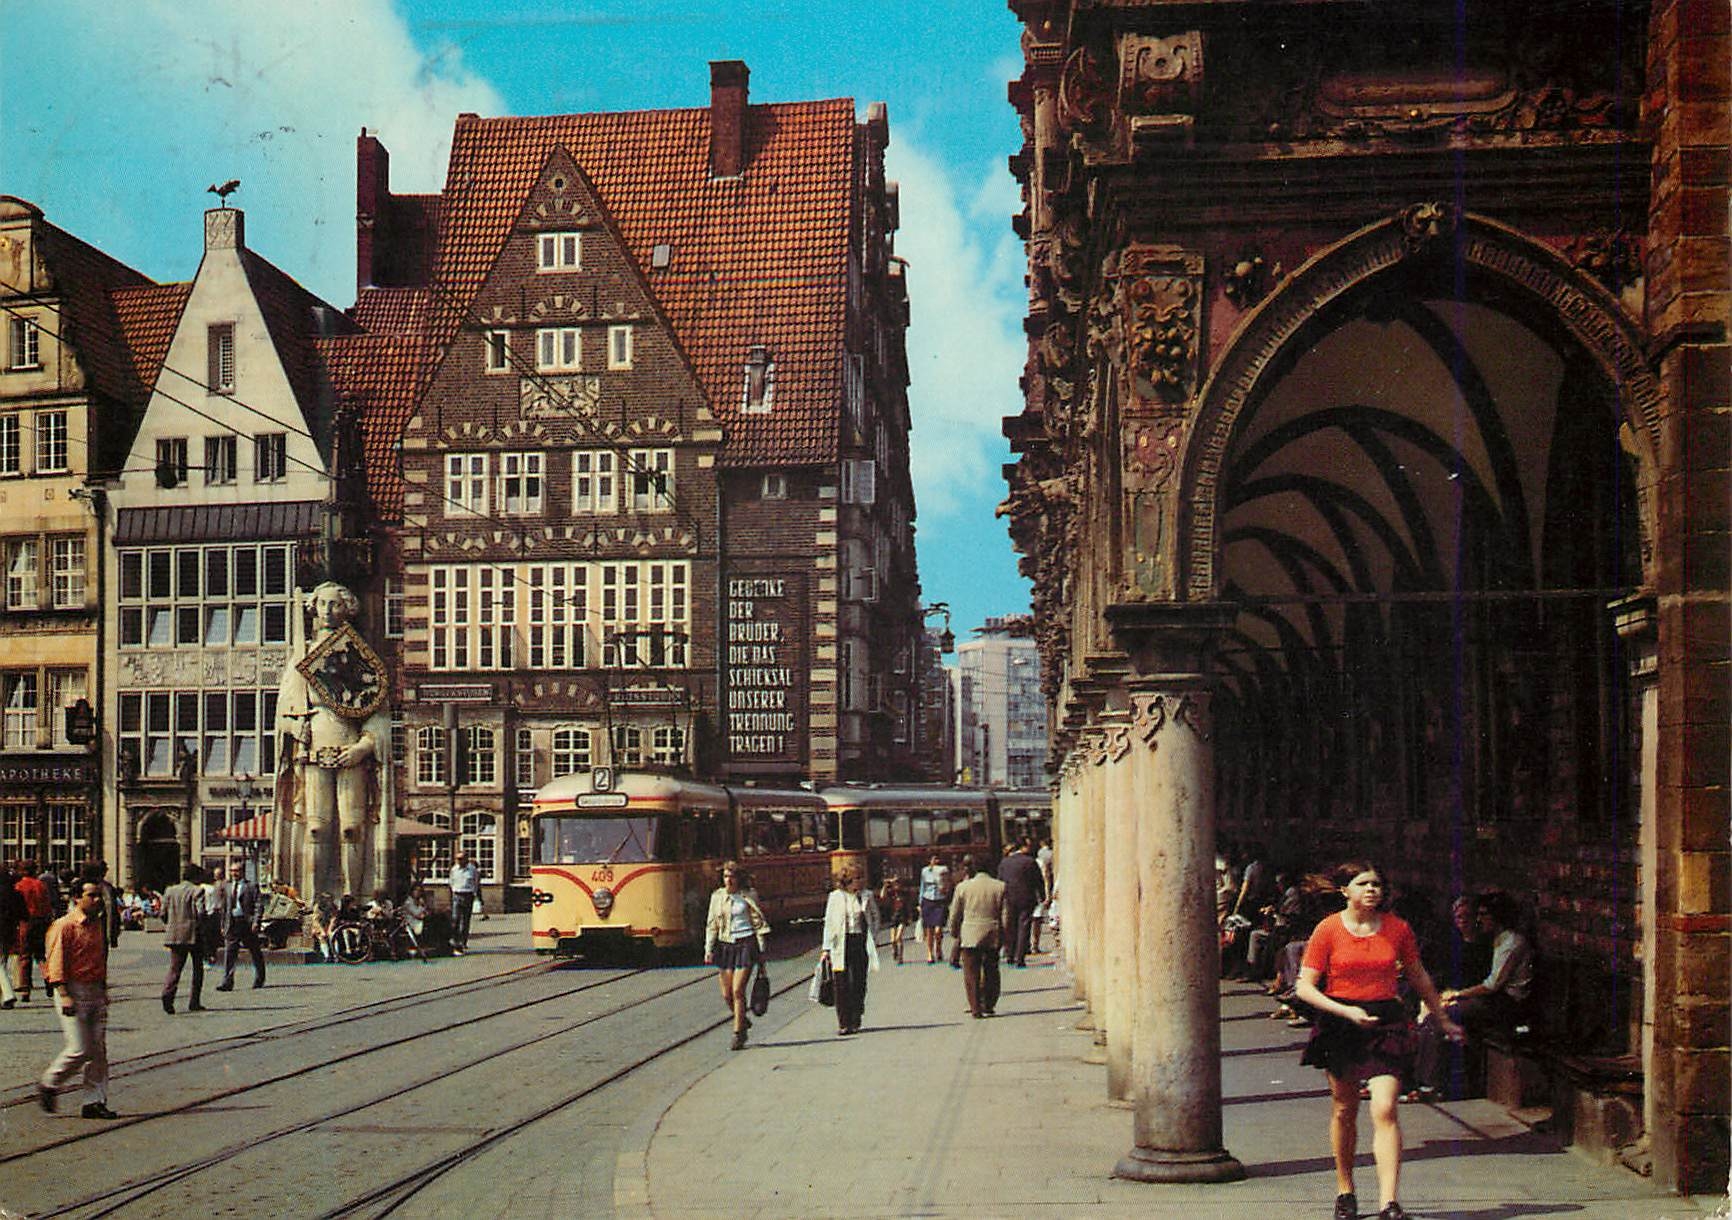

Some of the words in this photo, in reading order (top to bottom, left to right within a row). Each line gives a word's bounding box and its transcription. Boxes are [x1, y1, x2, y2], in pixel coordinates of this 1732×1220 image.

[729, 601, 754, 619] DER
[729, 646, 749, 665] DIE
[753, 646, 776, 665] DAS
[729, 668, 793, 687] SCHICKSAL
[729, 690, 785, 709] UNSERER
[730, 713, 795, 731] TRENNUNG
[596, 769, 608, 788] 2
[591, 870, 614, 882] 409
